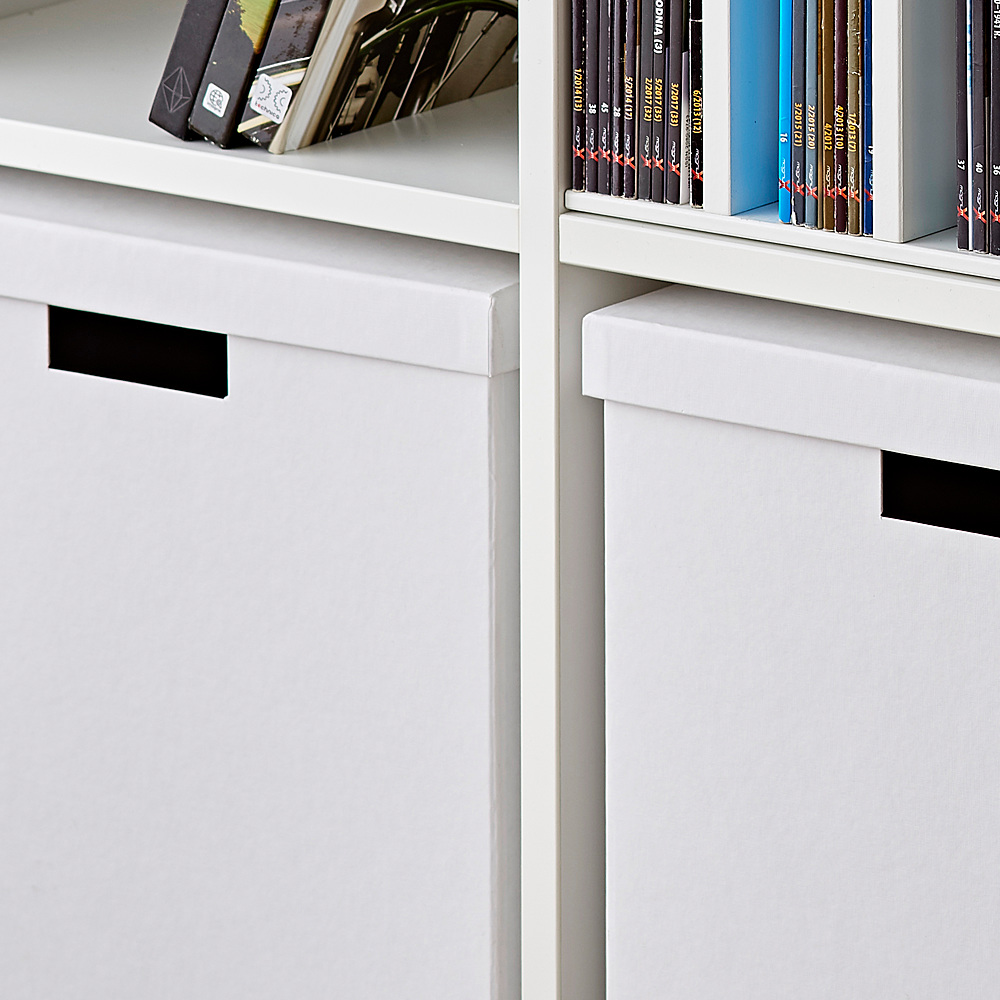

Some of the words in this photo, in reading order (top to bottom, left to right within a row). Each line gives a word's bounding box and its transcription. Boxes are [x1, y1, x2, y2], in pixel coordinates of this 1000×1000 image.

[653, 39, 663, 54] (3)
[654, 78, 662, 105] 5/2017
[600, 102, 608, 113] 45
[692, 90, 701, 116] 6/2013
[654, 106, 663, 122] (35)
[692, 118, 701, 134] (12)
[780, 132, 788, 142] 16
[794, 130, 802, 147] (21)
[824, 123, 832, 150] 4/2012
[957, 159, 965, 170] 37
